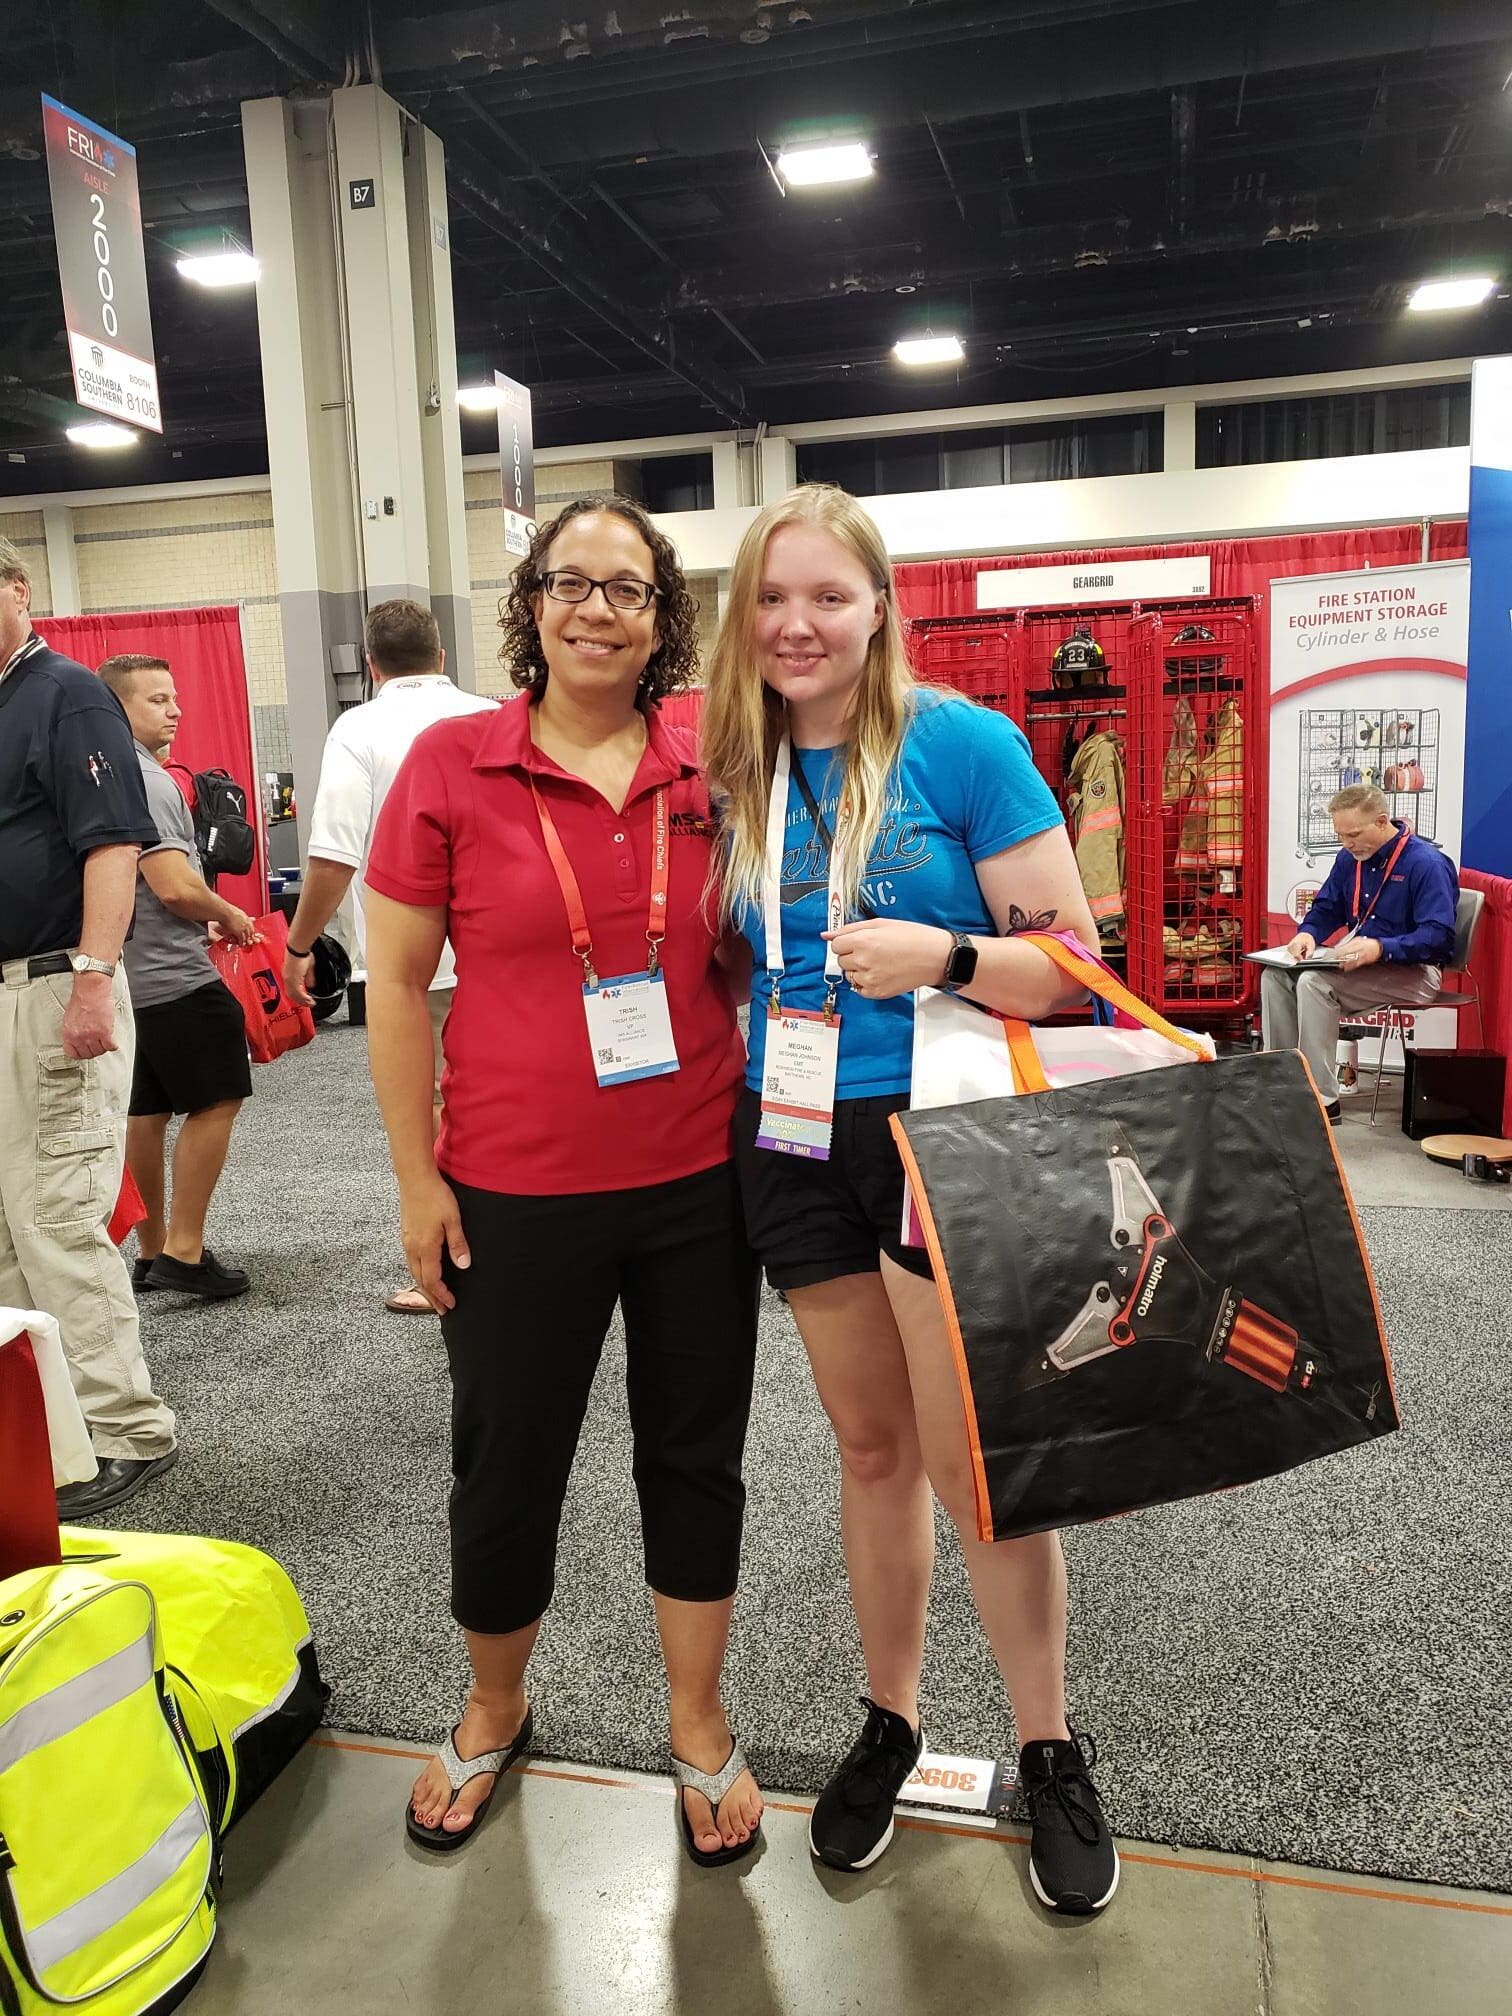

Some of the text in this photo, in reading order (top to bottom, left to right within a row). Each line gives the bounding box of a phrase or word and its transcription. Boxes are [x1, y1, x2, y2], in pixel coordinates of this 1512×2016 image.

[67, 127, 94, 160] FRI
[84, 172, 111, 194] AISLE
[353, 186, 370, 203] B7
[90, 193, 118, 337] 2000
[78, 367, 122, 394] COLUMBIA
[82, 381, 123, 405] SOUTHERN
[126, 392, 157, 419] 8106
[513, 423, 522, 508] 1000
[1073, 575, 1114, 589] GEARGRID
[1318, 587, 1416, 608] FIRE STATION
[1289, 602, 1448, 628] EQUIPMENT STORAGE
[1296, 625, 1440, 651] Cylinder & Hose
[1068, 649, 1085, 662] 23
[669, 812, 695, 827] MS
[656, 830, 665, 845] Fire
[655, 846, 665, 871] Chiefs
[860, 880, 897, 907] NC
[618, 1006, 638, 1015] TRISH
[778, 1050, 821, 1062] MEGHAN JOHNSON
[787, 1042, 813, 1051] MEGHAN
[775, 1140, 811, 1156] FIRST TIMER
[1137, 1255, 1168, 1317] holmatro
[1001, 1766, 1018, 1786] FRI
